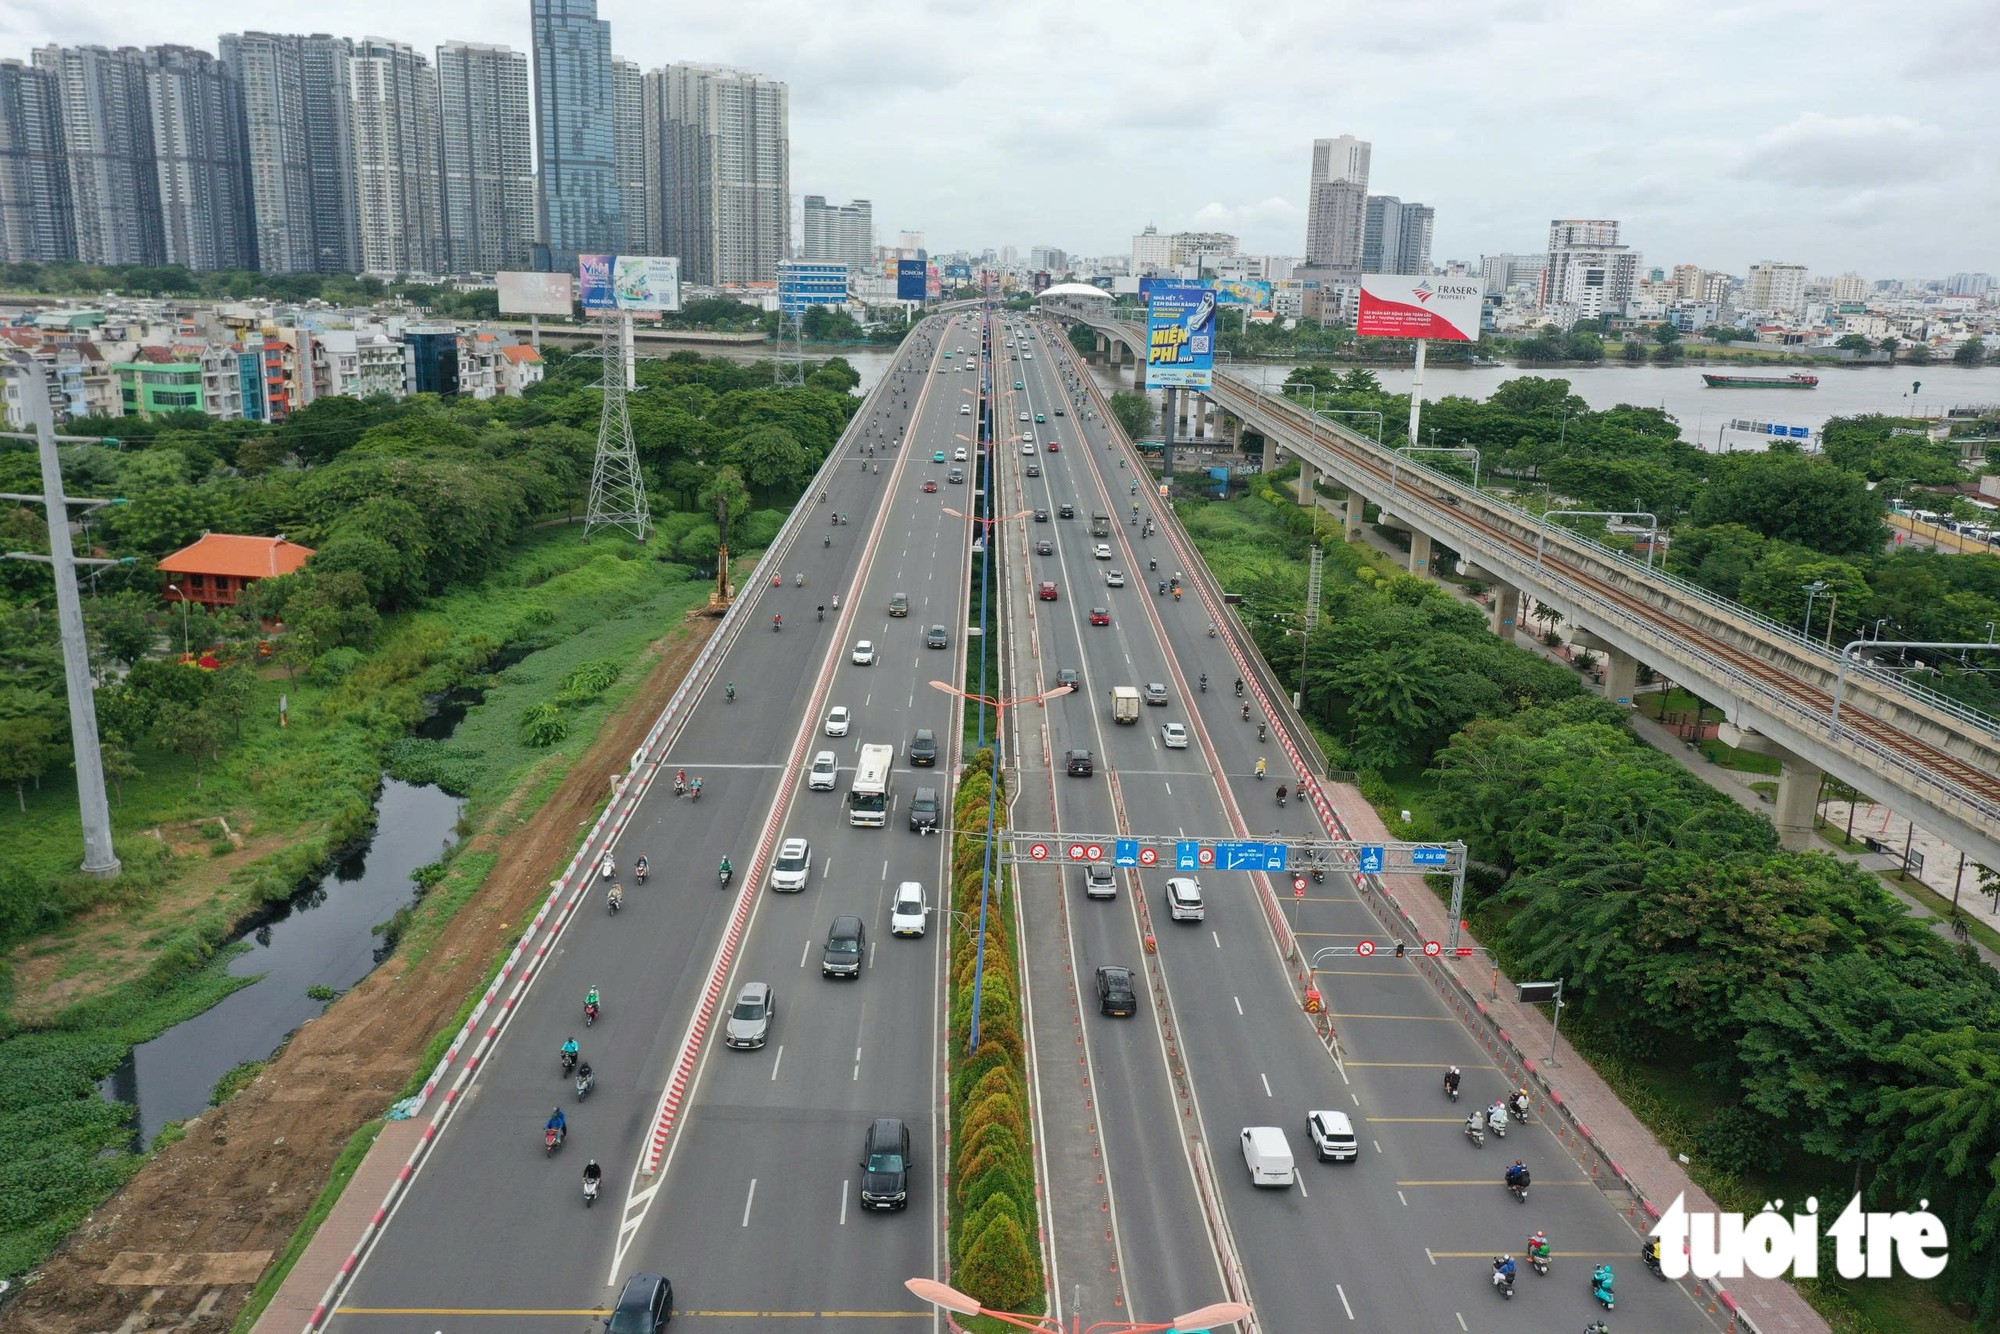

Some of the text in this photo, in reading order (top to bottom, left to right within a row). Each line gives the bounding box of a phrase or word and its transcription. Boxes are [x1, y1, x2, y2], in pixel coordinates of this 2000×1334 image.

[1438, 285, 1478, 295] FRASERS
[1152, 324, 1188, 344] MIỄN
[1150, 343, 1179, 362] PHÍ
